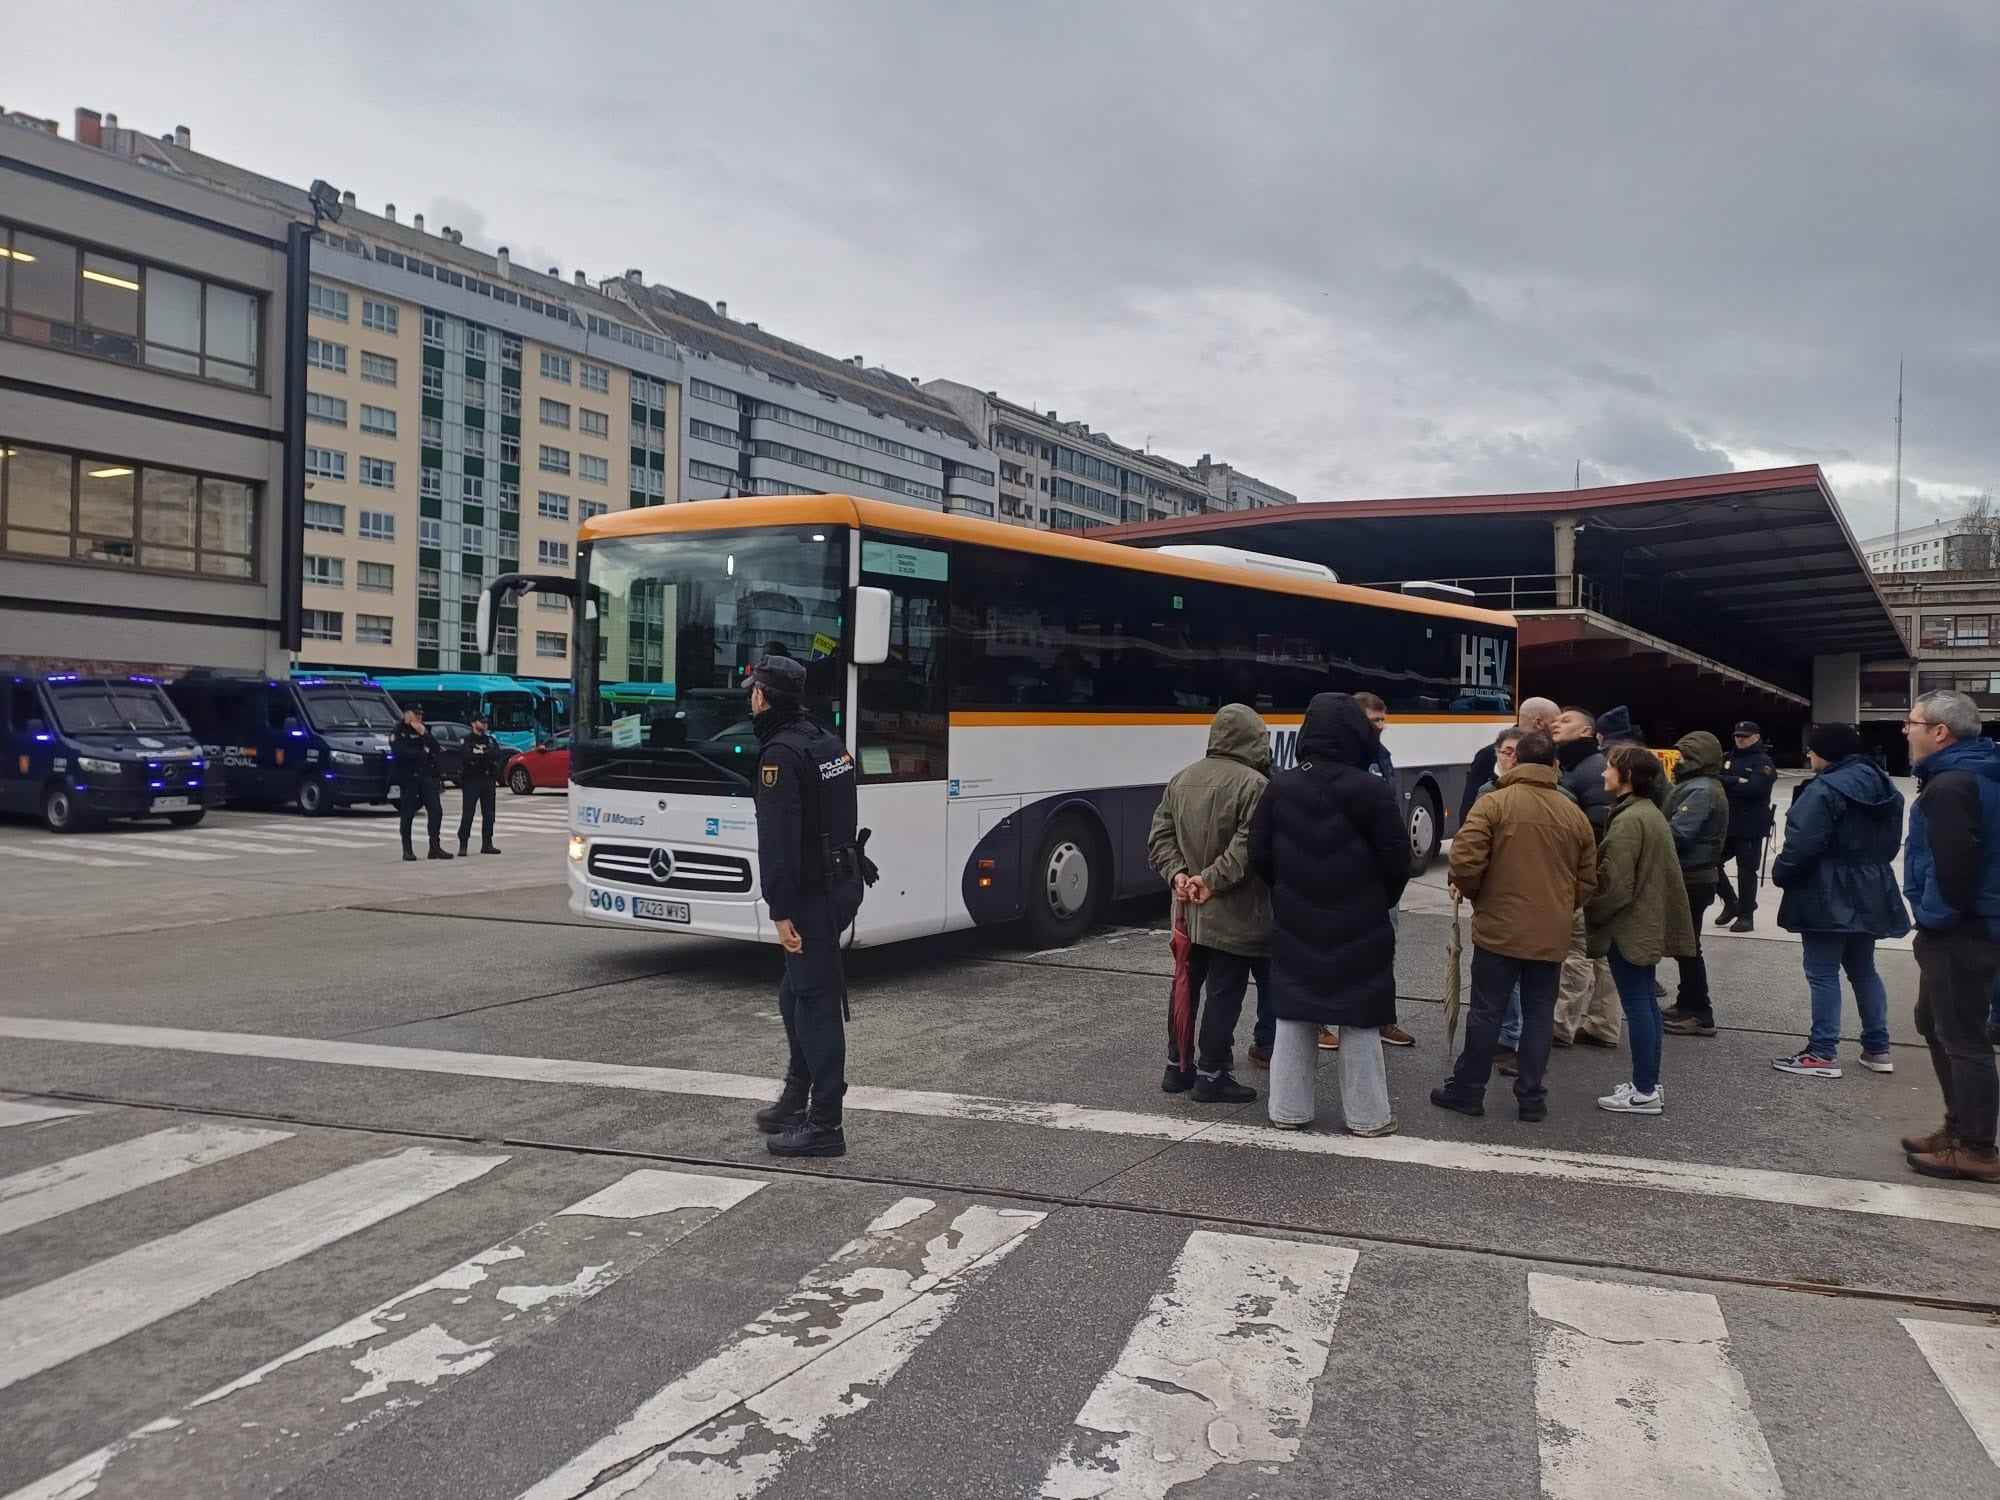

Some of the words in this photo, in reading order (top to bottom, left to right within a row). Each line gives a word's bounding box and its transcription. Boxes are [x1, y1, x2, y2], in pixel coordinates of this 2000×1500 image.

[1461, 634, 1508, 688] HEV
[578, 806, 601, 824] HEV
[639, 900, 664, 916] 7423
